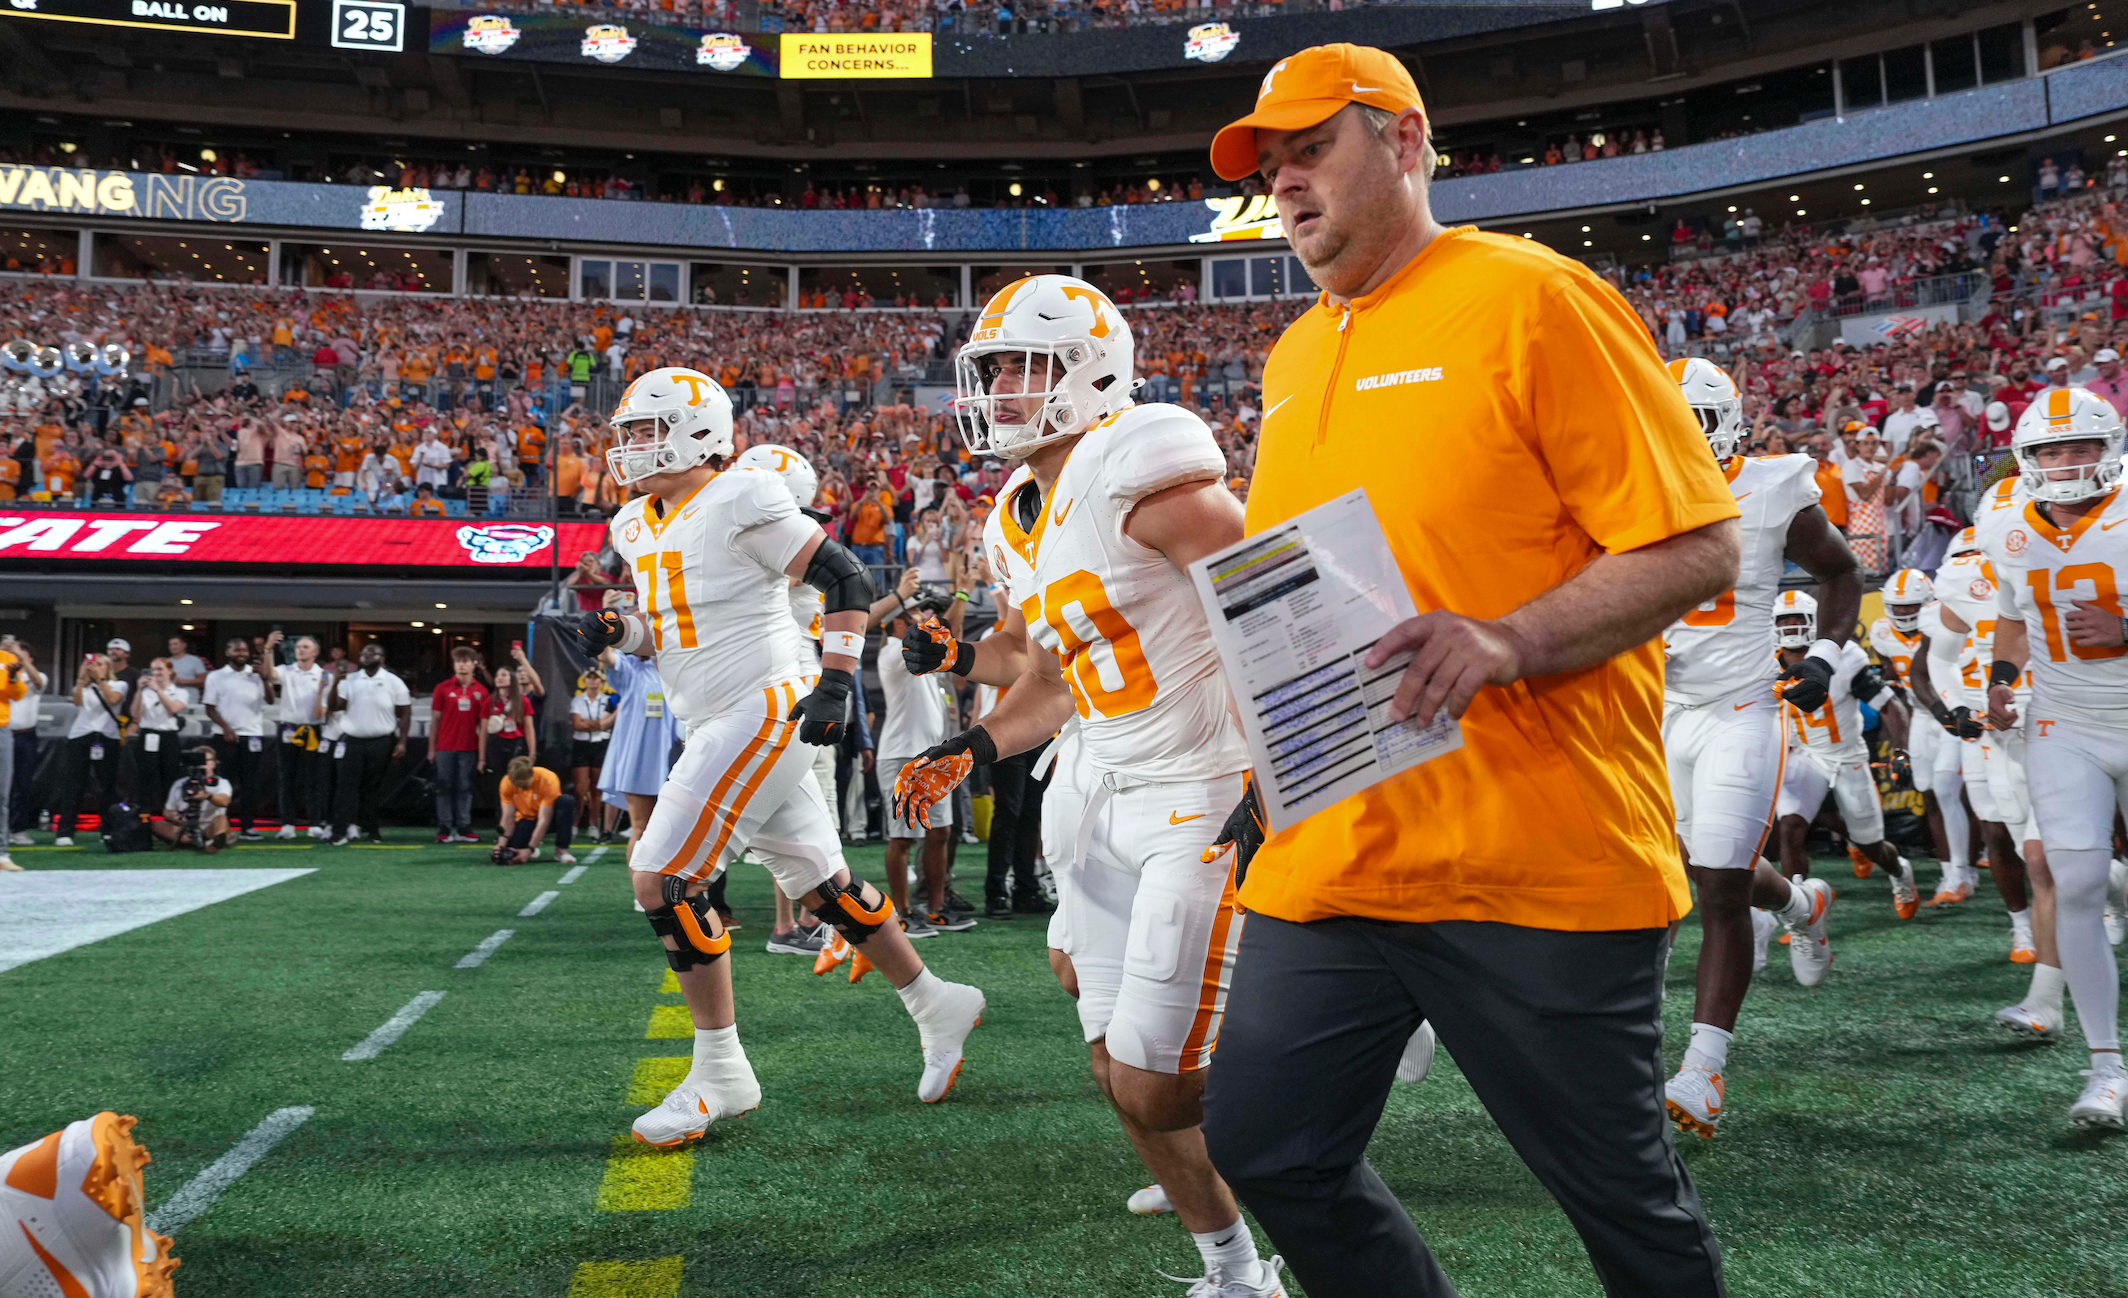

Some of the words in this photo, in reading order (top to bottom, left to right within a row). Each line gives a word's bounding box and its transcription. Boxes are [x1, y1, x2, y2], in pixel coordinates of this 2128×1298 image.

[132, 0, 189, 21] BALL
[193, 5, 228, 23] ON
[342, 10, 394, 41] 25
[799, 44, 830, 54] FAN
[836, 44, 917, 54] BEHAVIOR
[807, 59, 909, 70] CONCERNS...
[1060, 286, 1115, 342] T
[973, 329, 997, 341] VOLS
[1356, 366, 1444, 391] VOLUNTEERS
[671, 375, 710, 408] T
[2047, 425, 2072, 433] VOLS
[771, 449, 798, 472] T
[654, 523, 664, 538] T
[2056, 534, 2073, 549] T
[1025, 541, 1035, 564] T
[842, 635, 852, 647] T
[2036, 720, 2056, 737] T
[1982, 745, 1991, 760] T
